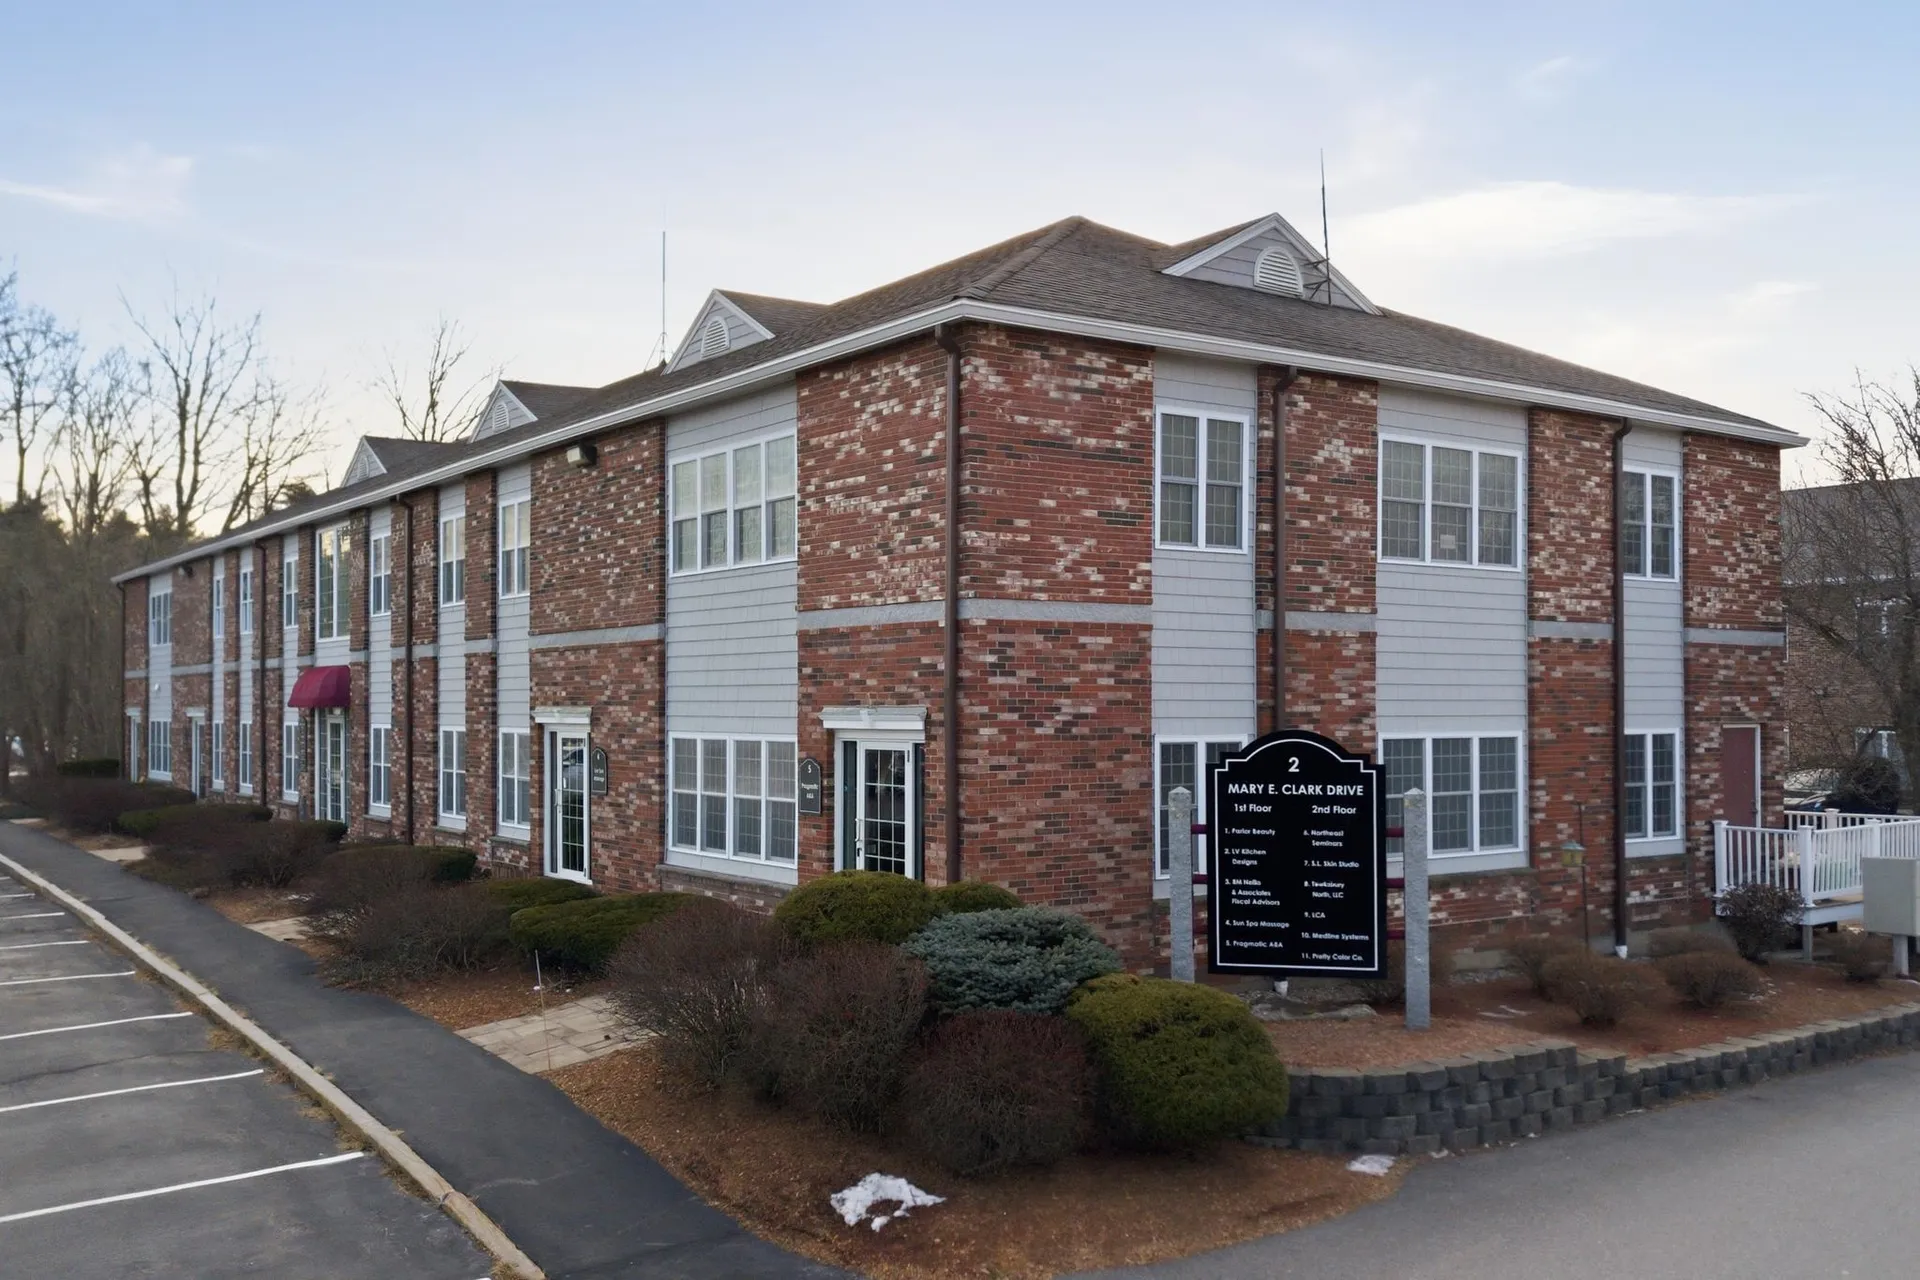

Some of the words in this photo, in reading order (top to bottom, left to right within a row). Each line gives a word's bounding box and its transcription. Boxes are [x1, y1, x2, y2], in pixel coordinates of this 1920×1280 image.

[1287, 756, 1300, 773] 2
[1227, 783, 1265, 795] MARY
[1267, 783, 1279, 795] E.
[1281, 783, 1324, 796] CLARK
[1326, 784, 1364, 796] DRIVE
[1234, 803, 1247, 813] 1st
[1248, 803, 1272, 813] Floor
[1311, 804, 1331, 814] 2nd
[1332, 805, 1357, 815] Floor
[1231, 827, 1251, 835] Parlor
[1252, 828, 1276, 836] Beauty
[1311, 829, 1344, 837] Northeast
[1311, 839, 1343, 847] Seminars
[1231, 858, 1258, 867] Designs
[1311, 880, 1345, 889] Tewksbury
[1237, 889, 1272, 897] Associates
[1332, 891, 1344, 899] LLC
[1252, 898, 1281, 906] Advisors
[1245, 919, 1259, 928] Spa
[1259, 920, 1290, 929] Massage
[1301, 931, 1311, 939] 10.
[1341, 933, 1370, 941] Systems
[1225, 939, 1232, 947] 5.
[1232, 940, 1267, 949] Pragmatic
[1301, 952, 1311, 960] 11.
[1311, 953, 1331, 962] Pretty
[1331, 953, 1351, 961] Color
